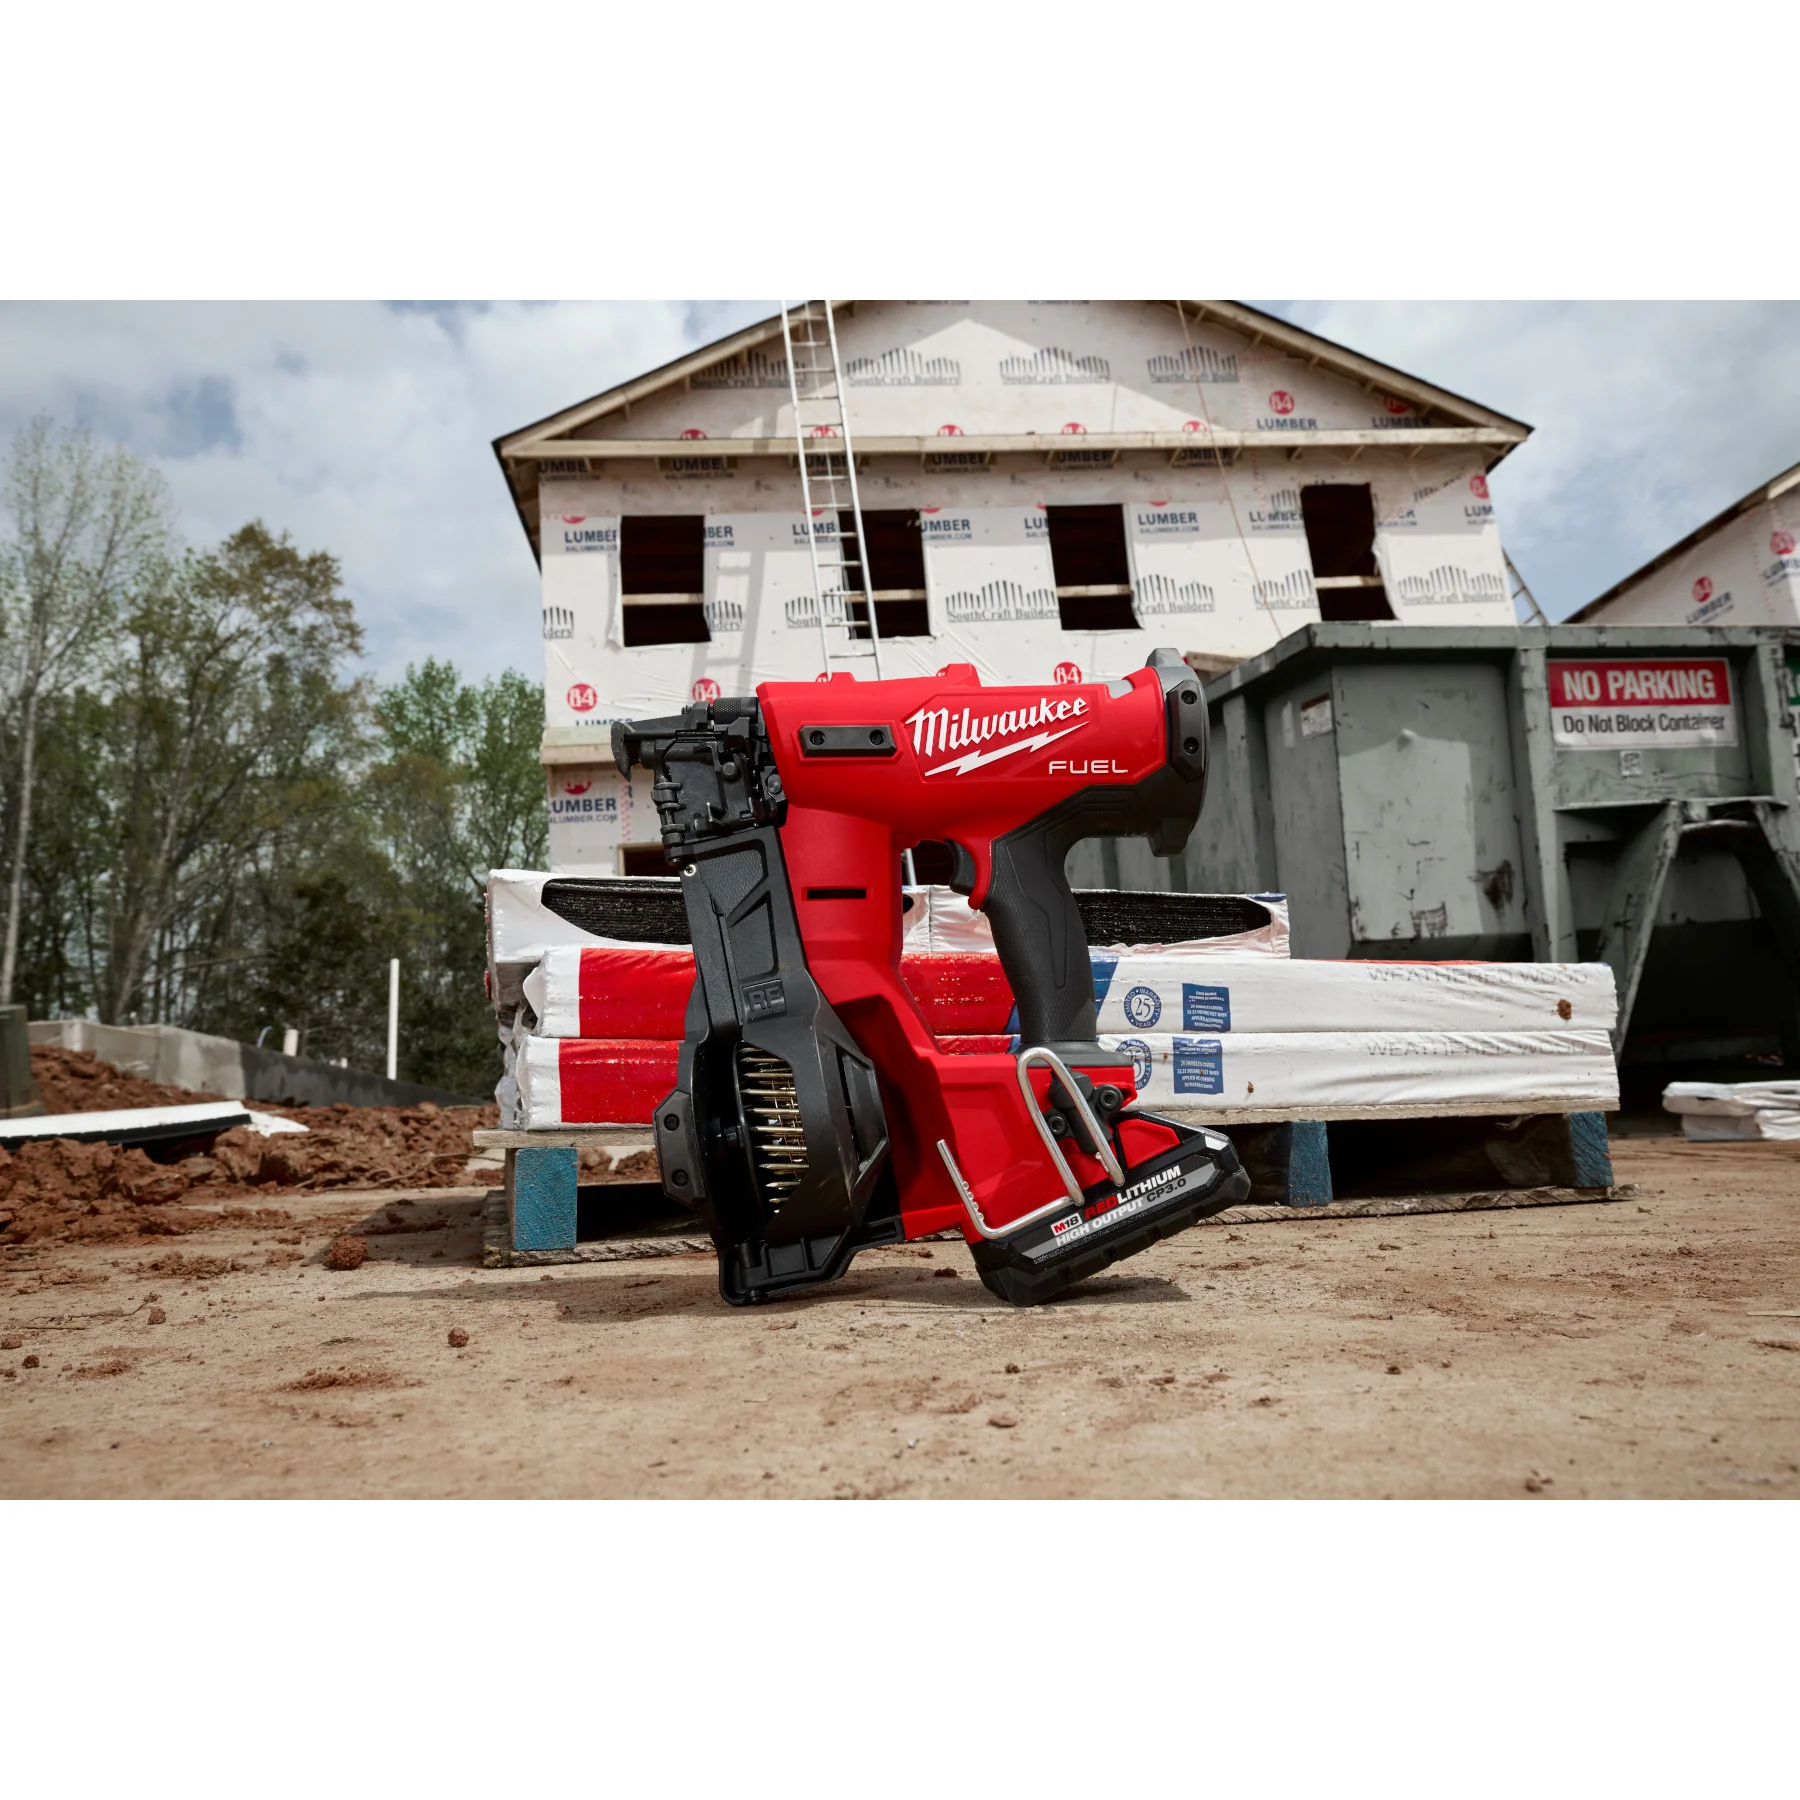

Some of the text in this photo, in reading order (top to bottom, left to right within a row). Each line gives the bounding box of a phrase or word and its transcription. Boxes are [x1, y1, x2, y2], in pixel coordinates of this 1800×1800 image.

[1257, 418, 1317, 429] LUMBER
[921, 519, 971, 532] UMBER
[1137, 512, 1197, 526] LUMBER
[948, 608, 1012, 620] SouthCraft
[1562, 669, 1717, 701] NO PARKING
[570, 686, 594, 707] 84
[905, 697, 1089, 757] Milwaukee
[1563, 714, 1725, 734] Do Not Block Container
[1048, 760, 1128, 775] FUEL
[550, 798, 616, 814] UMBER
[749, 986, 780, 1012] RF
[1135, 997, 1151, 1018] 25
[1053, 1165, 1181, 1234] M18 REDLITHIUM
[1055, 1178, 1186, 1246] HIGH OUTPUT CP3.0
